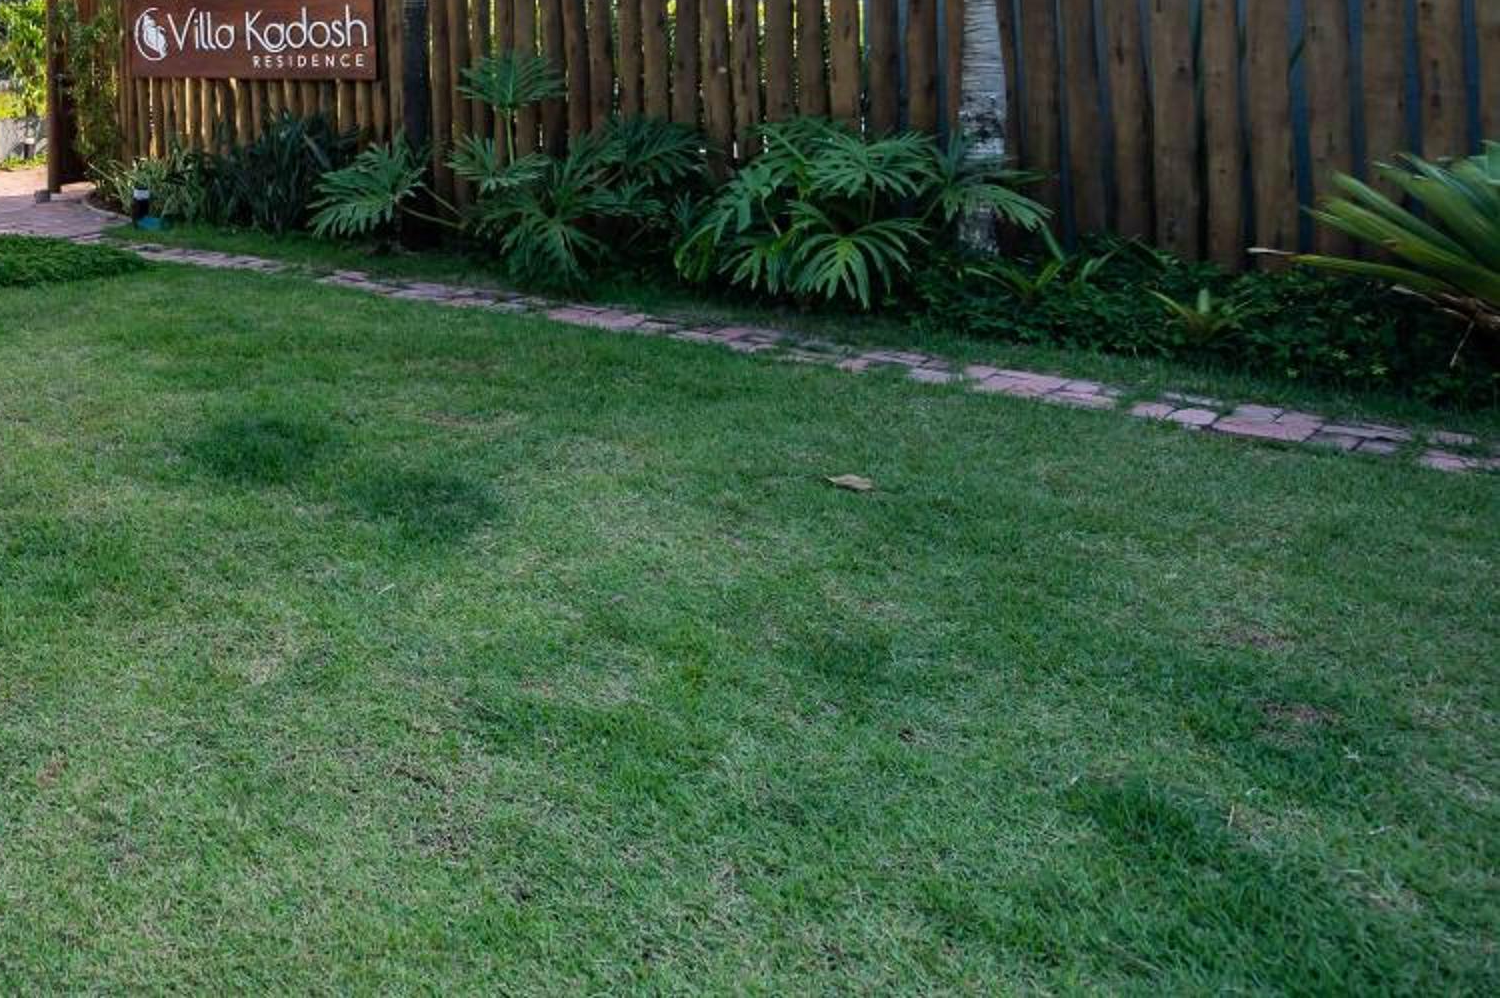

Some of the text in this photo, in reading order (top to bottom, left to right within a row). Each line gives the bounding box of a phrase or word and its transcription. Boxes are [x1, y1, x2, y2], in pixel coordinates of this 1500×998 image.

[167, 3, 367, 53] Villa Kadosh
[252, 53, 365, 69] RESIDENCE
